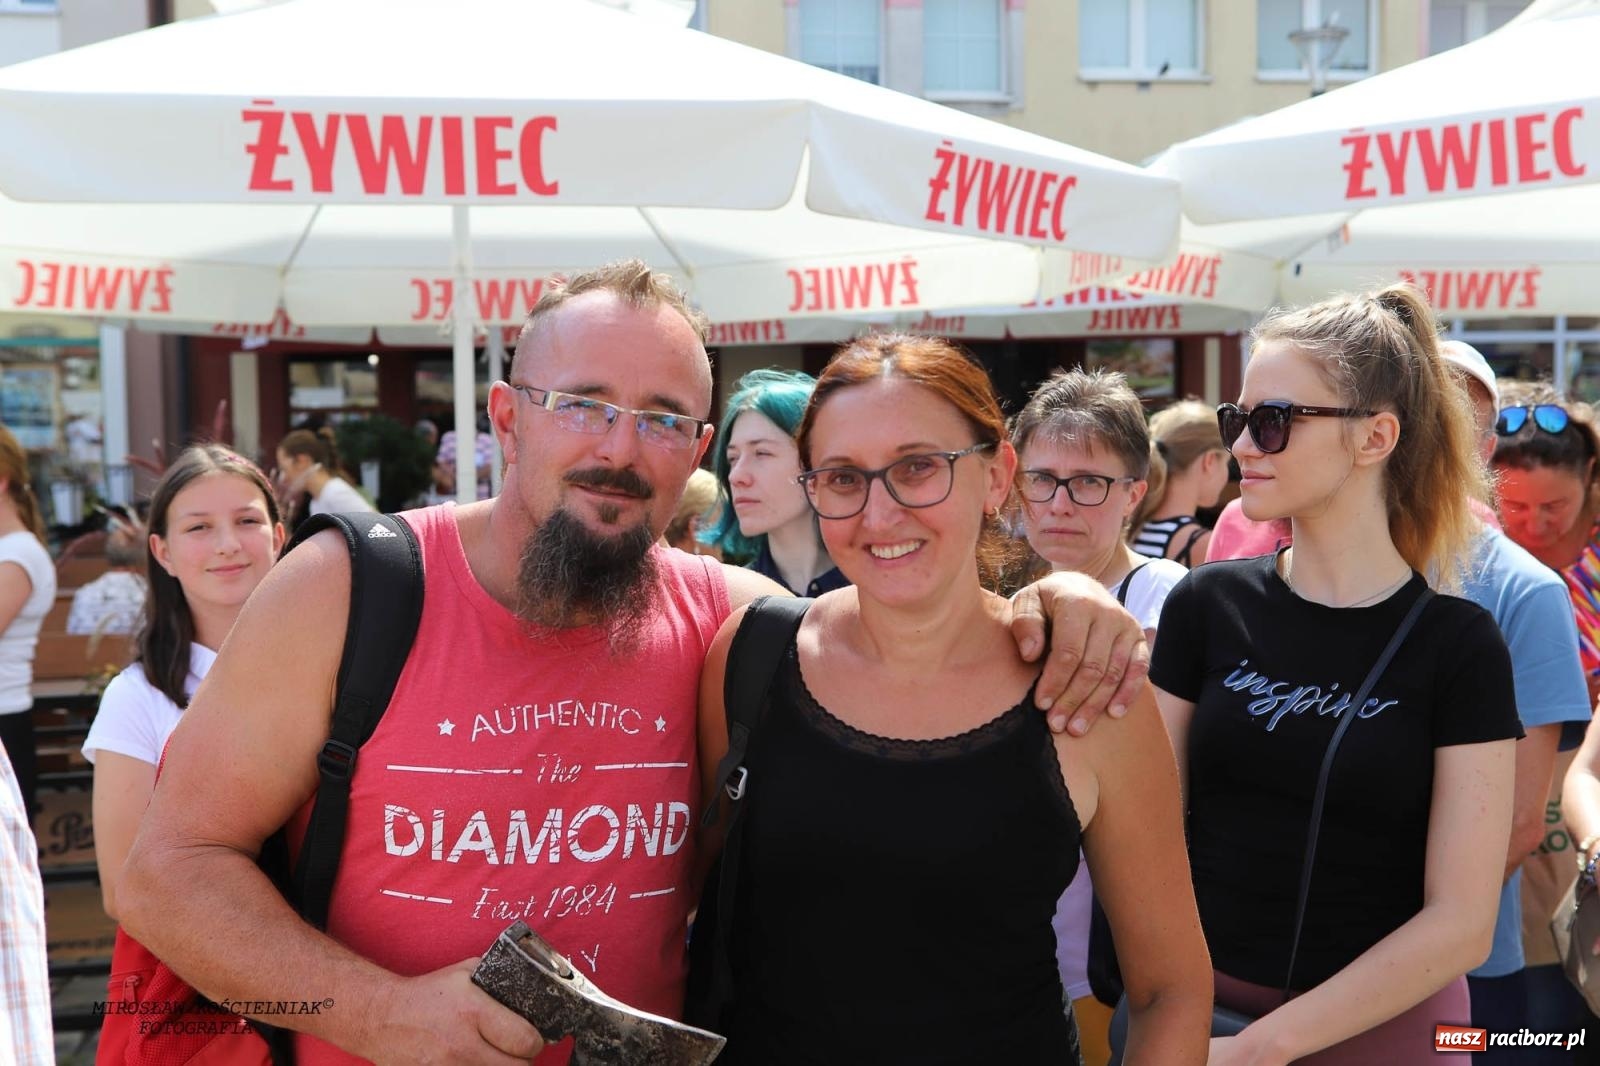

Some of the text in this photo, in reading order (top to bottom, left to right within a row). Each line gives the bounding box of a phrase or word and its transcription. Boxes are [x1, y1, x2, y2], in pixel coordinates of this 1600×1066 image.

[241, 99, 560, 197] ŻYWIEC
[1340, 106, 1587, 200] ŻYWIEC
[925, 140, 1078, 242] ŻYWIEC
[367, 531, 397, 539] adidas
[471, 700, 642, 742] AUTHENTIC
[536, 753, 582, 783] The
[384, 801, 690, 865] DIAMOND
[543, 882, 617, 918] 1984
